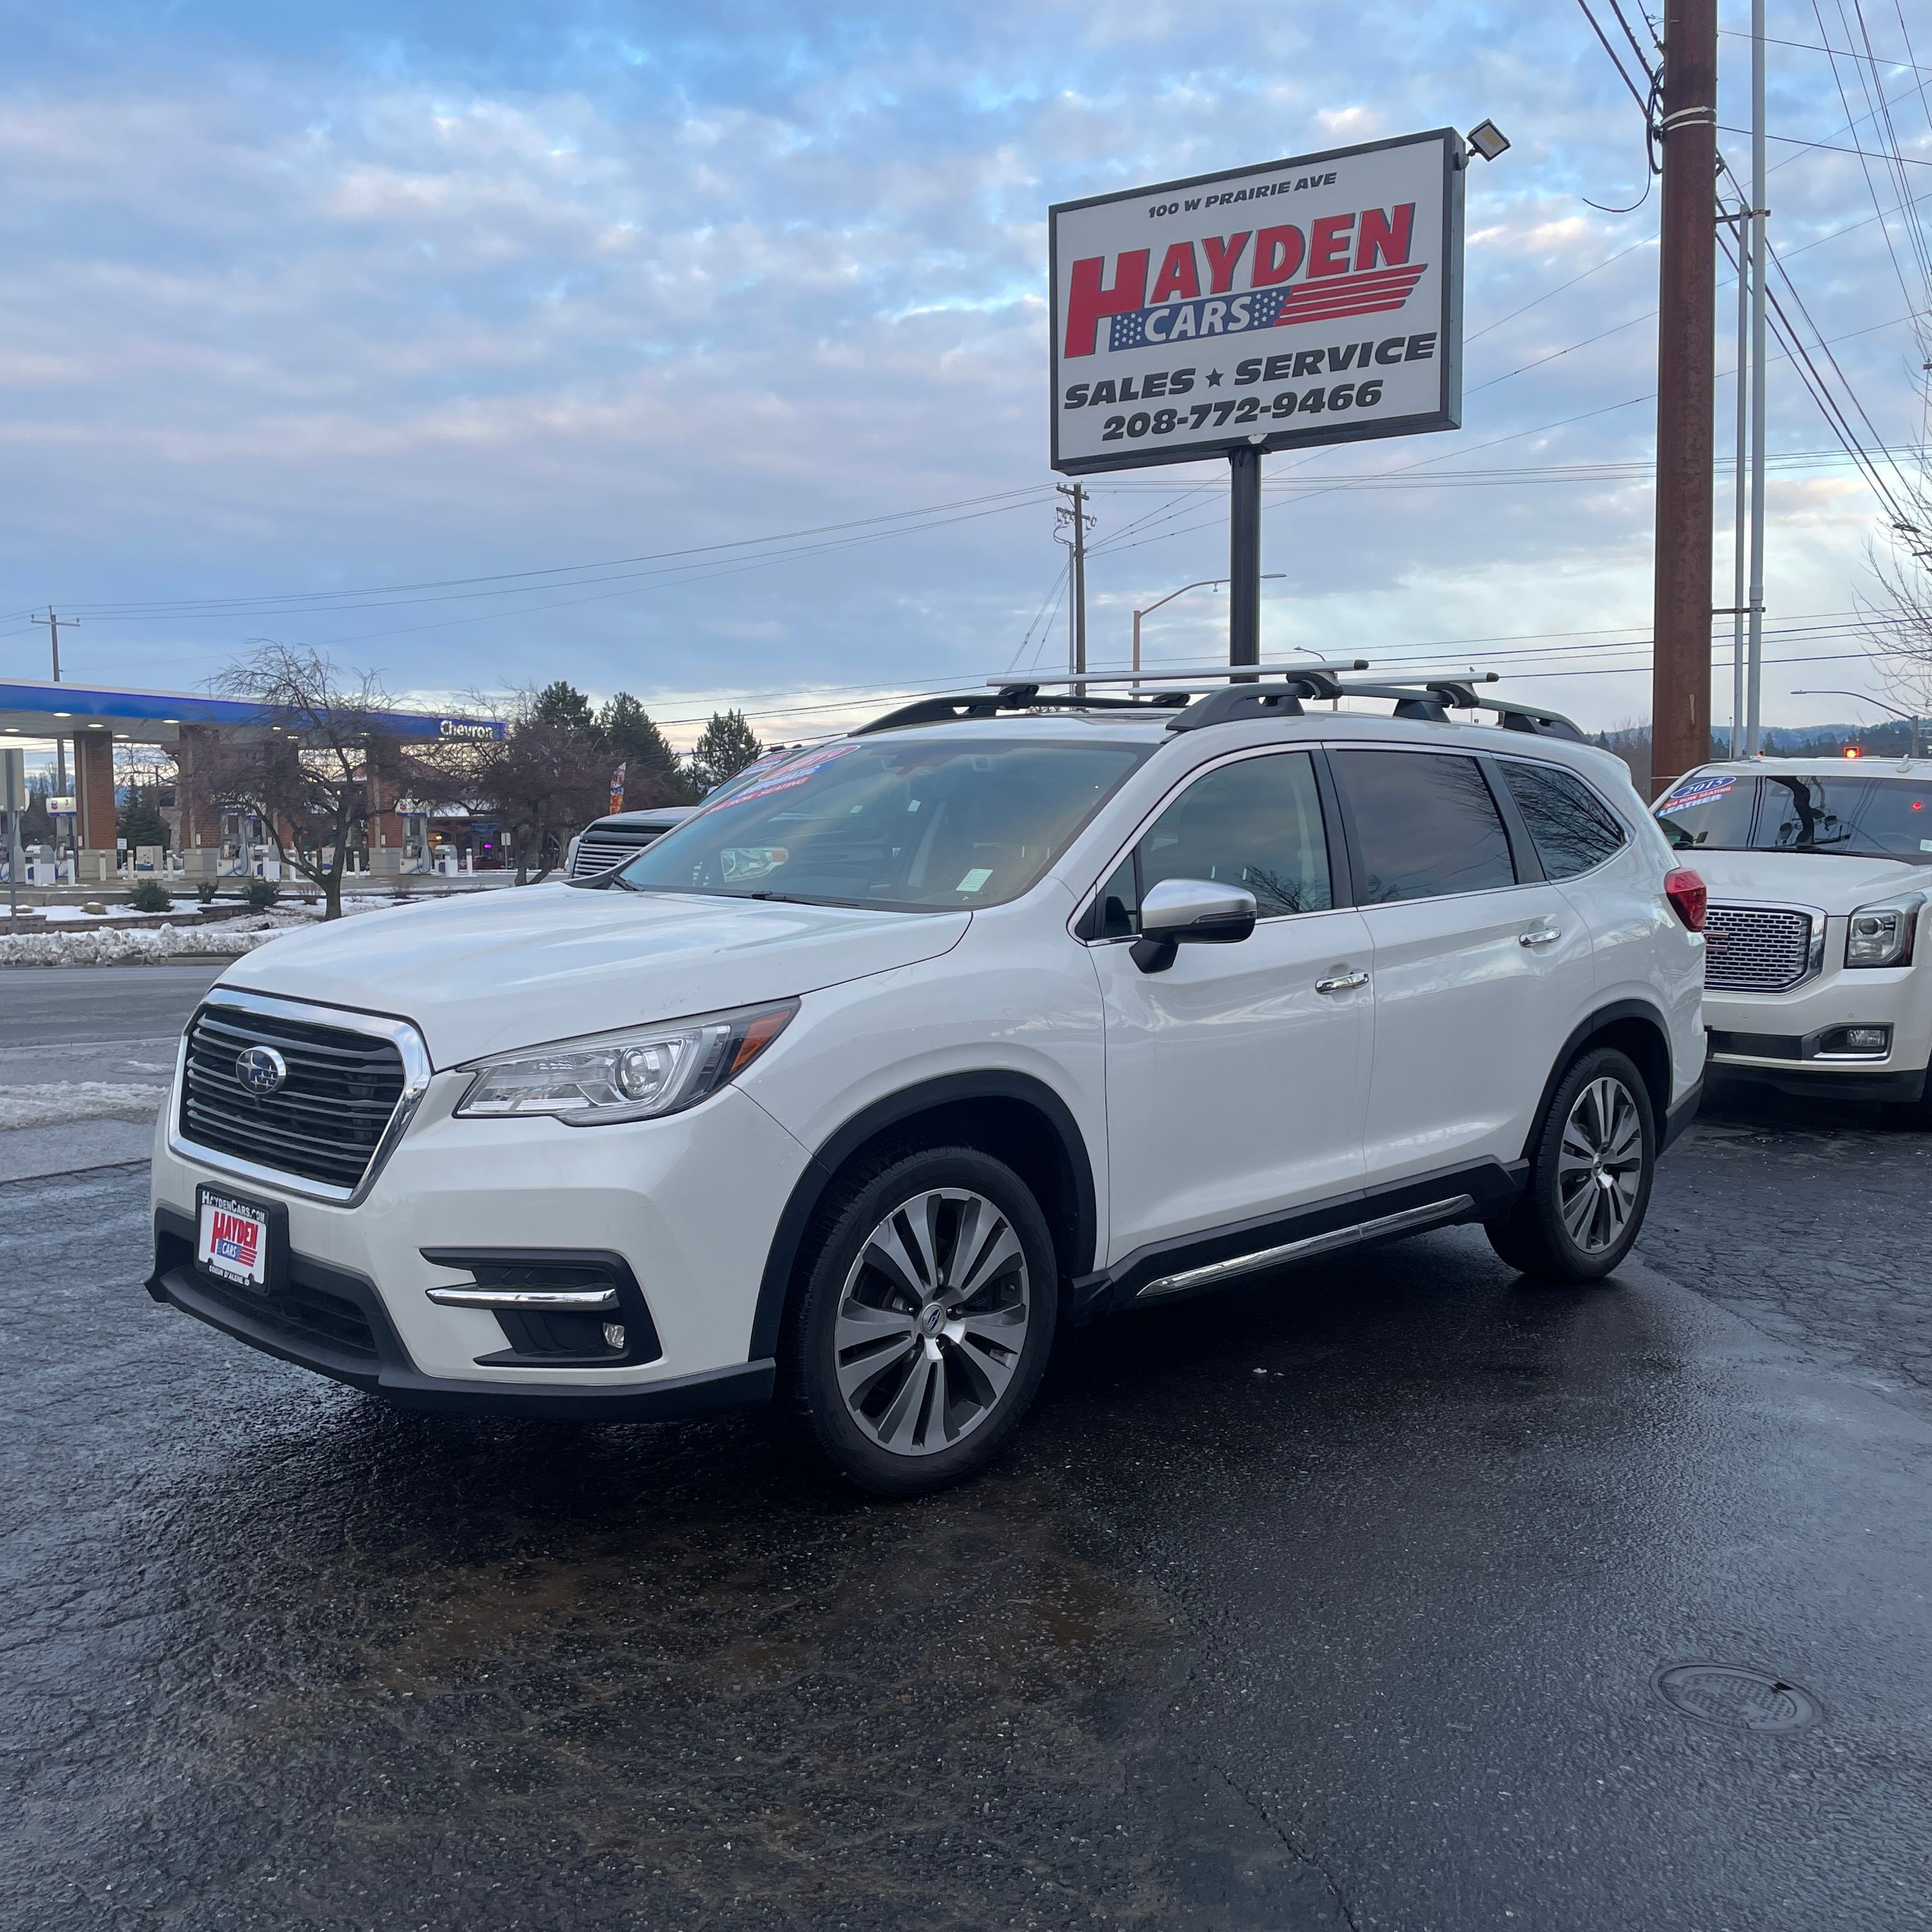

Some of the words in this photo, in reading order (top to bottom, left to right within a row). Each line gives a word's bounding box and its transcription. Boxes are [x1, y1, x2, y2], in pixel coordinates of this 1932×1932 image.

[1148, 202, 1179, 218] 100
[1184, 198, 1202, 212] W
[1205, 181, 1291, 208] PRAIRIE
[1294, 172, 1337, 191] AVE
[1064, 203, 1416, 359] HAYDEN
[1144, 296, 1252, 342] CARS
[1064, 368, 1197, 410] SALES
[1234, 332, 1438, 385] SERVICE
[1102, 379, 1384, 441] 208-772-9466
[440, 720, 493, 739] Chevron
[1659, 794, 1723, 817] LEATHER
[1680, 794, 1698, 803] ROW
[1699, 786, 1732, 797] SEATING
[1683, 778, 1724, 795] 2015
[210, 1211, 259, 1254] HAYDEN
[222, 1242, 238, 1258] CARS
